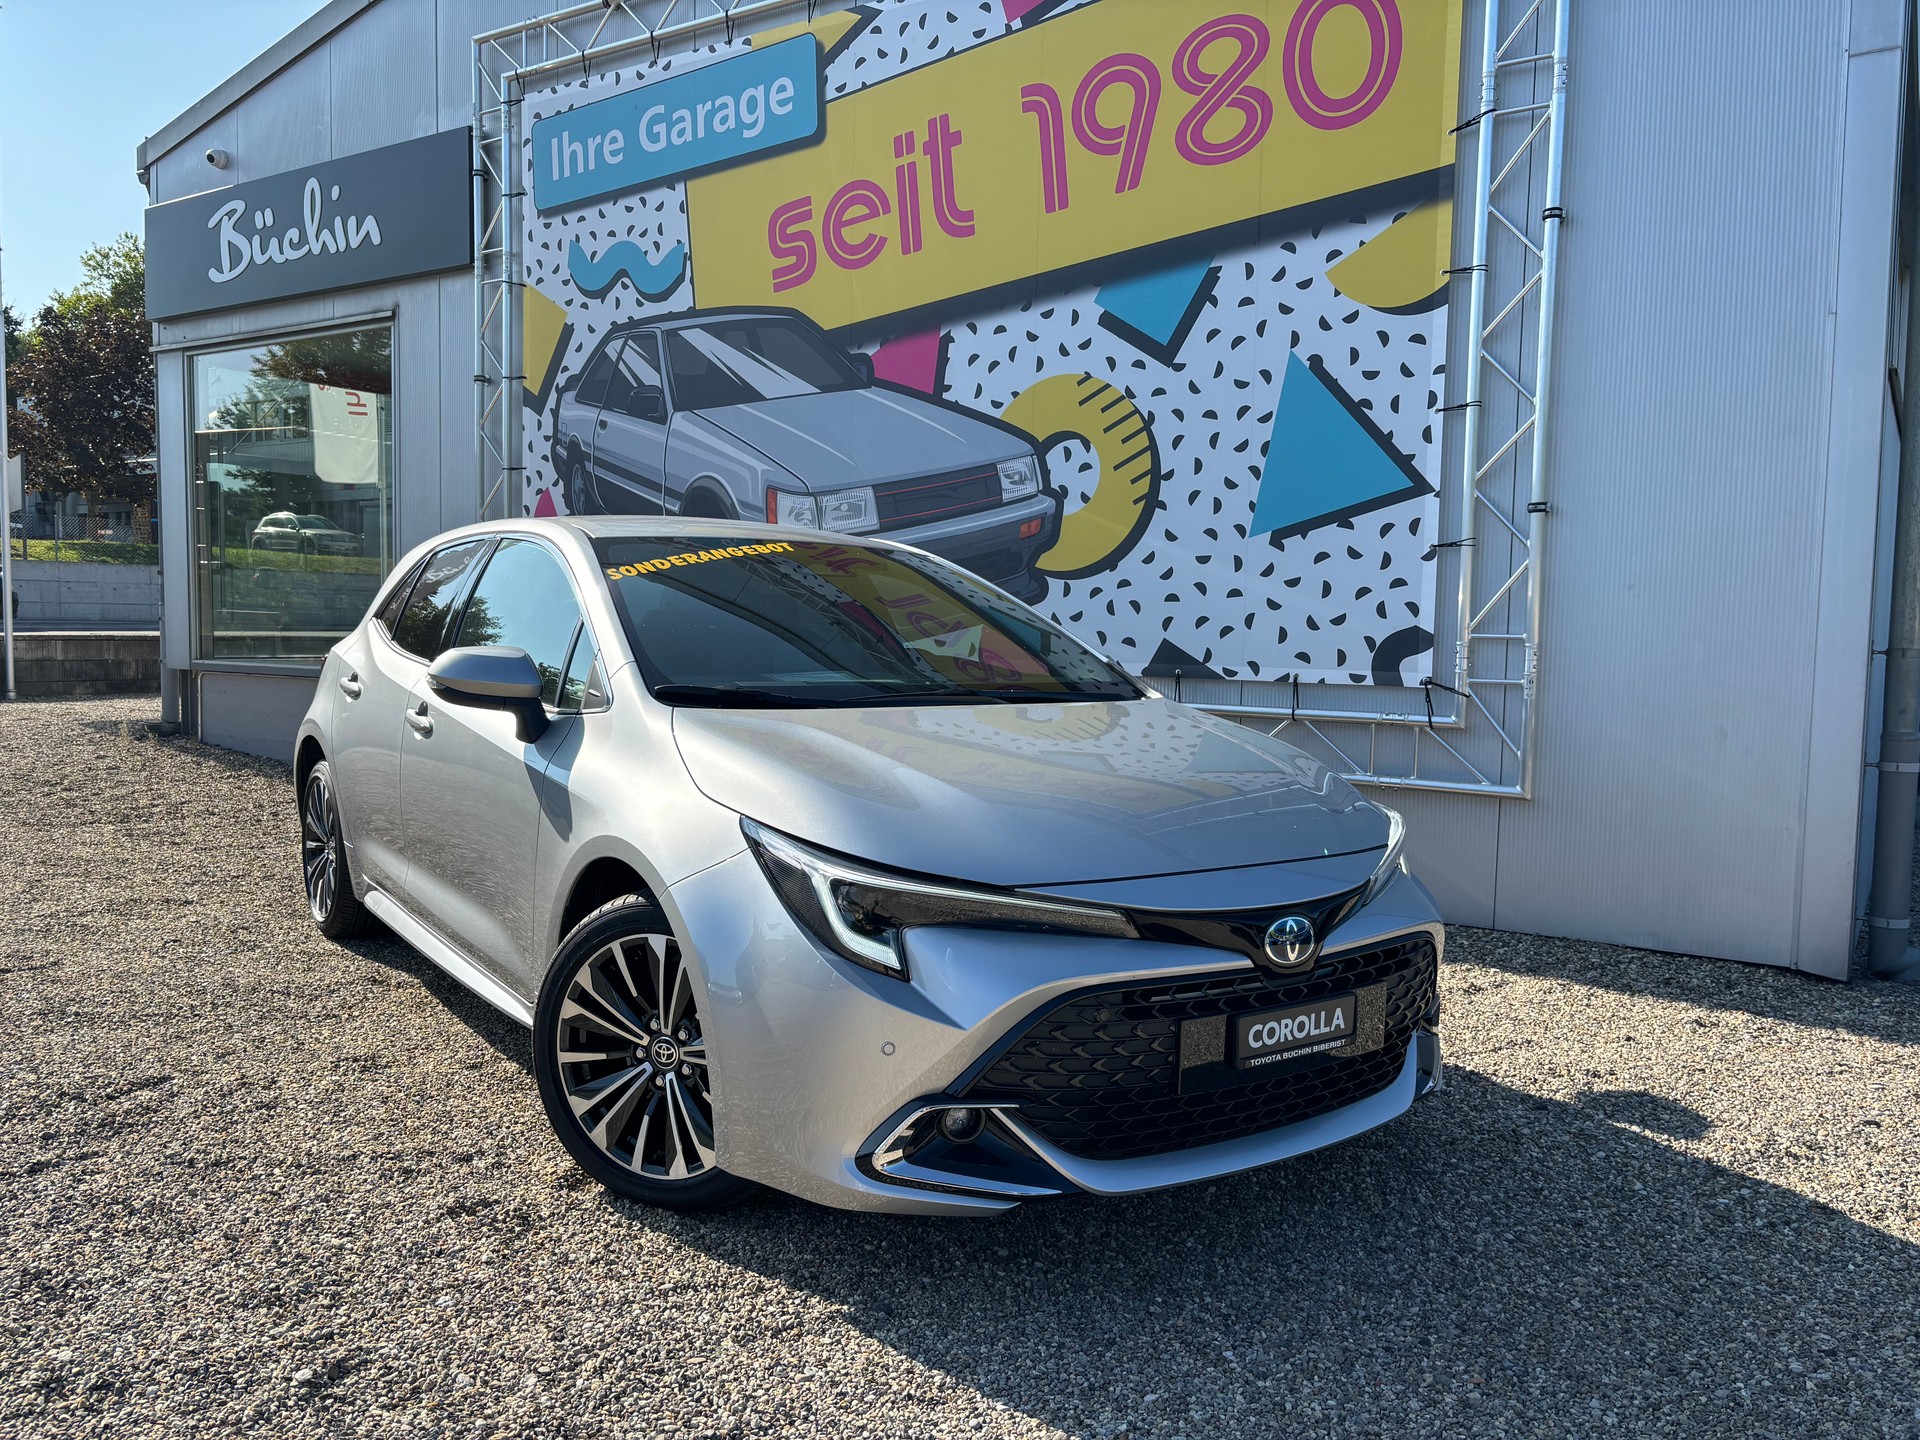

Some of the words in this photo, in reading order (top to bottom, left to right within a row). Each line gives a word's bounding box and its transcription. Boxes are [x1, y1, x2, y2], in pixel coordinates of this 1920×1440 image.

[550, 129, 625, 181] Ihre
[637, 76, 795, 153] Garage
[767, 113, 976, 293] seit
[1020, 0, 1403, 214] 1980
[207, 176, 382, 283] Büchin
[606, 542, 795, 580] SONDERANGEBOT
[1248, 1007, 1345, 1048] COROLLA
[1250, 1054, 1281, 1067] TOYOTA
[1313, 1039, 1346, 1053] BIBERIST
